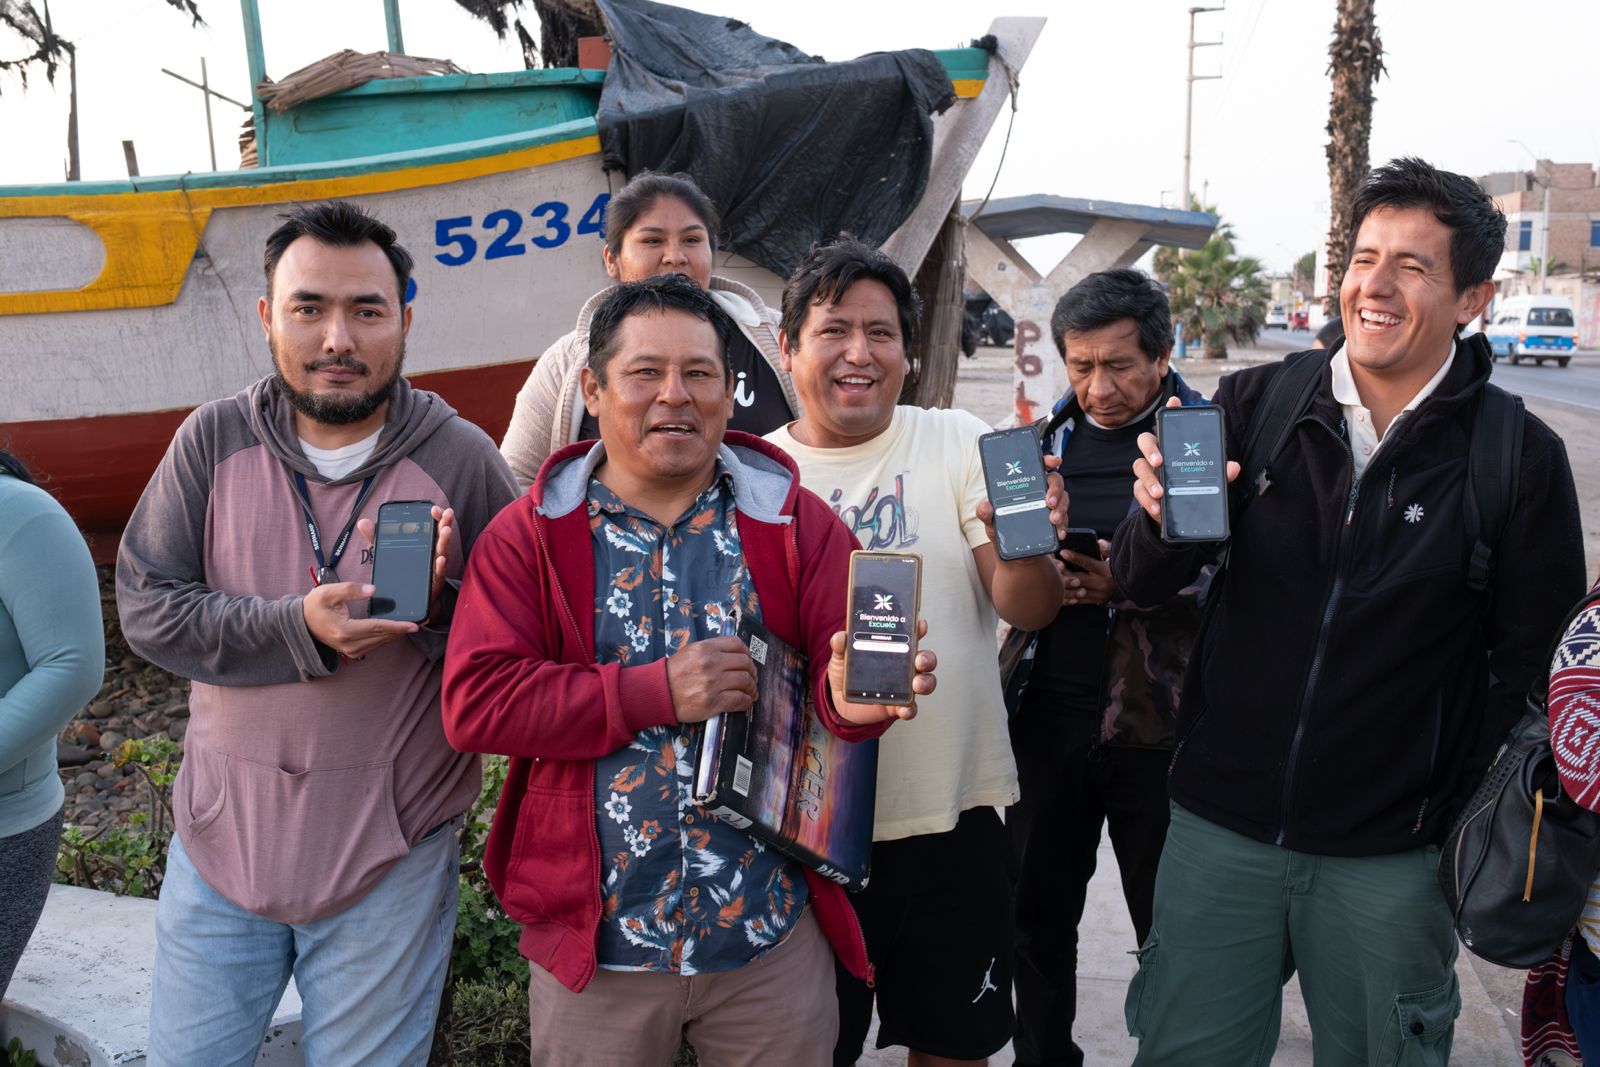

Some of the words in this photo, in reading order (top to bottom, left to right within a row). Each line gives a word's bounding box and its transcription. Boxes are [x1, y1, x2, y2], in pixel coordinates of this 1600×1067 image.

[435, 193, 612, 266] 5234
[860, 613, 899, 622] Bienvenido
[868, 621, 896, 629] Excuela
